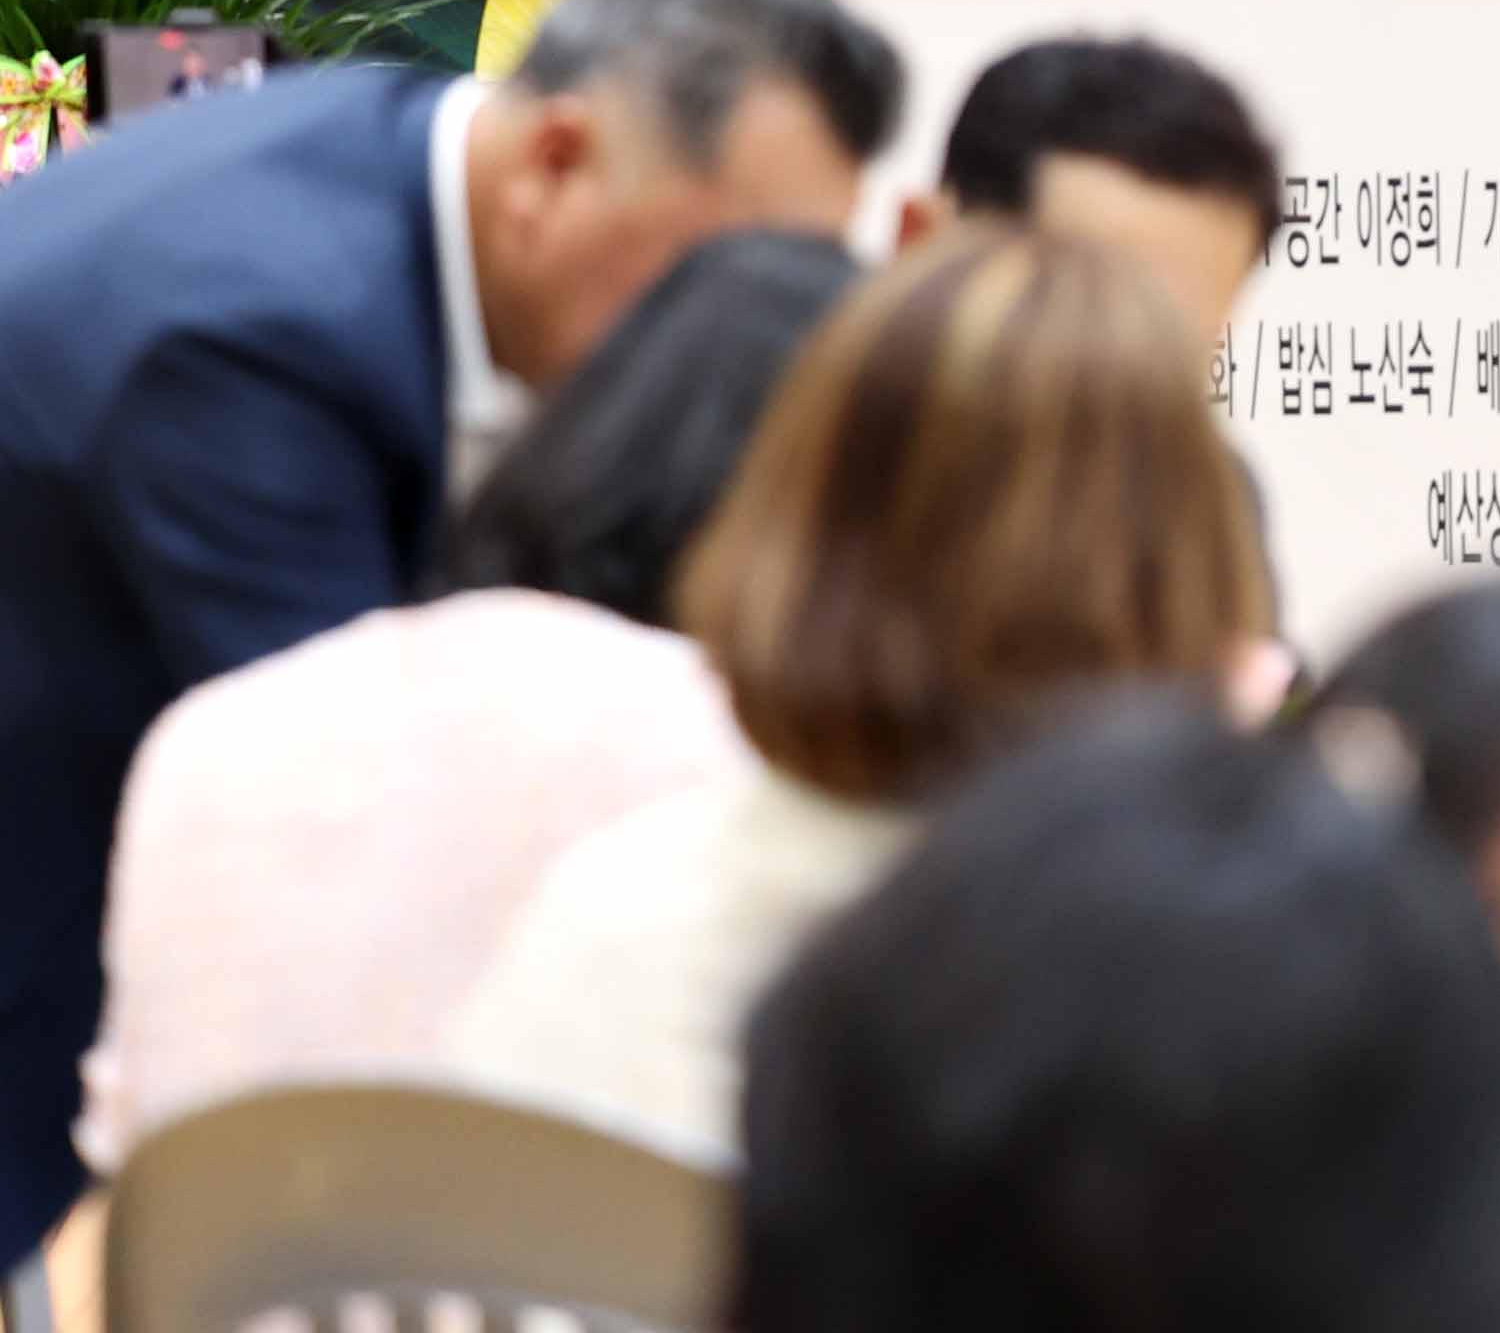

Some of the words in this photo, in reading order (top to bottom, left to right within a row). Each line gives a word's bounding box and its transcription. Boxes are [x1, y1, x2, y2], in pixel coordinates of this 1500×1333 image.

[1264, 171, 1341, 268] 공간
[1357, 169, 1441, 268] 이정희
[1278, 320, 1333, 416] 밥심
[1349, 319, 1435, 416] 노신숙
